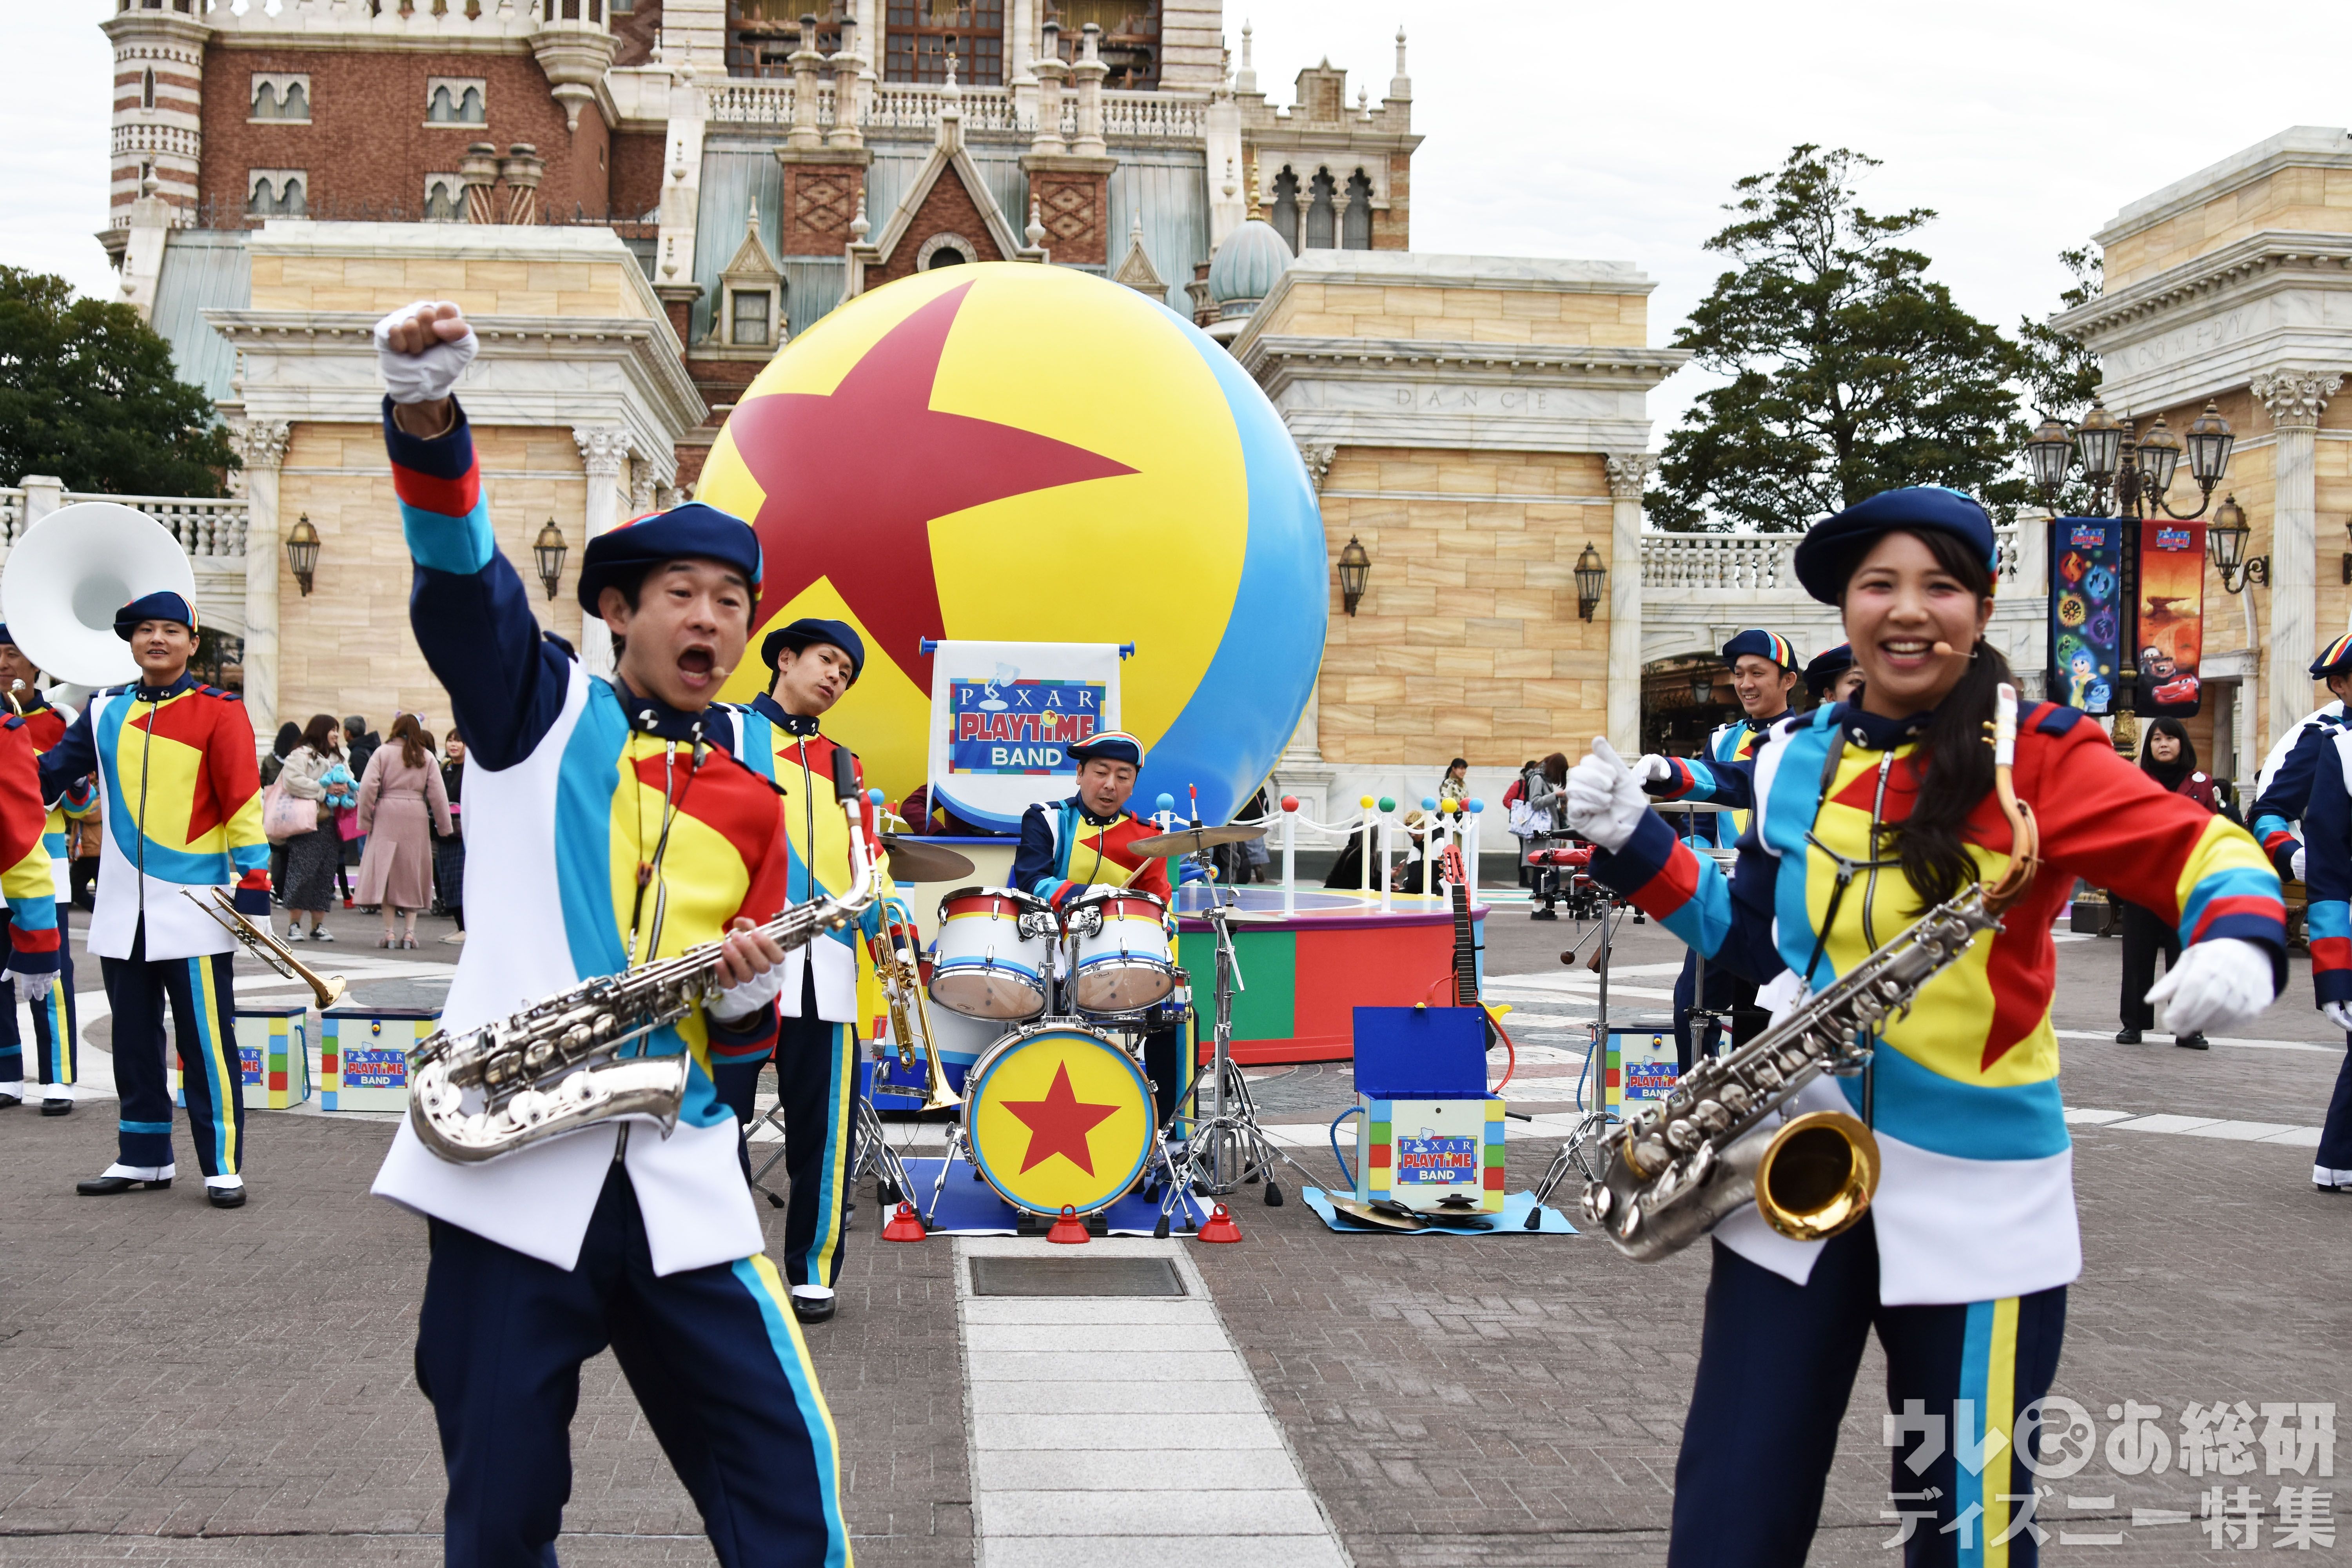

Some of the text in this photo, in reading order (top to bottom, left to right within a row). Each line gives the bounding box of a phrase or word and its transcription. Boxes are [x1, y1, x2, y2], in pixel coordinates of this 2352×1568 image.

[2138, 313, 2242, 366] COMEDY
[1397, 388, 1547, 410] DANCE
[992, 747, 1062, 766] BAND
[361, 1076, 390, 1085] BAND
[1419, 1170, 1455, 1180] BAND
